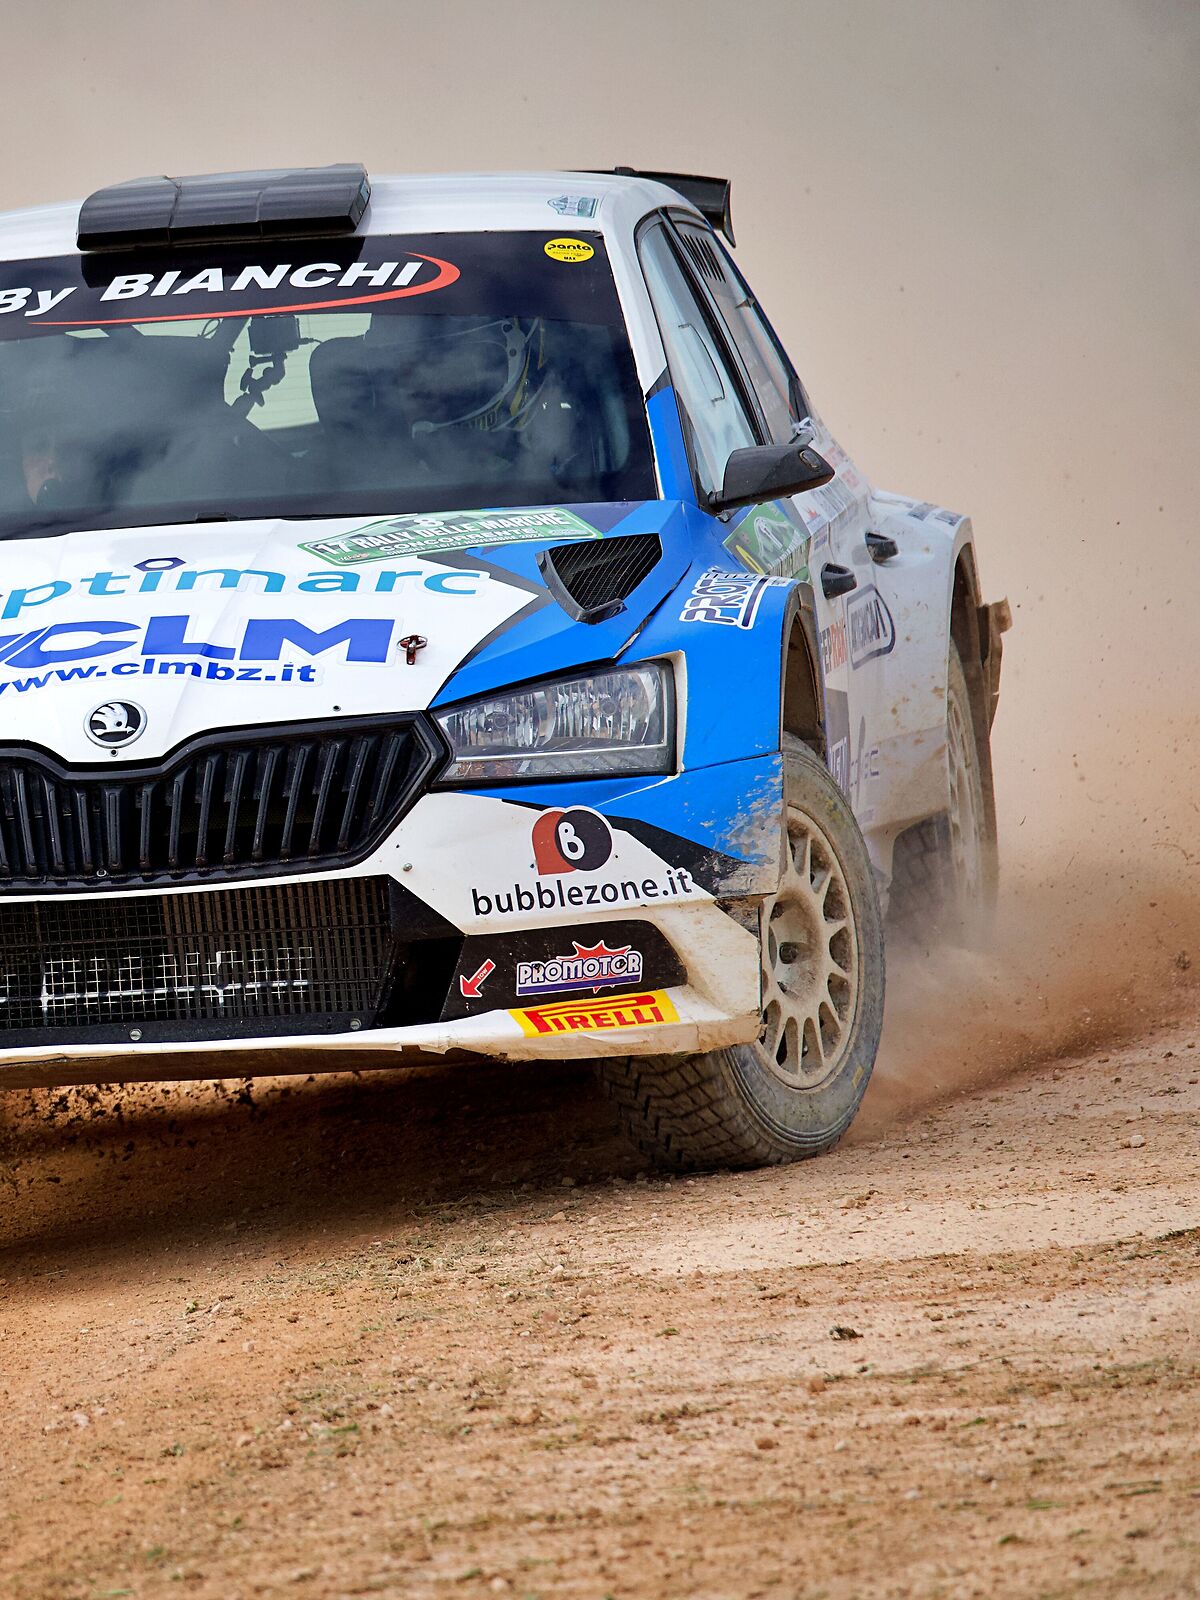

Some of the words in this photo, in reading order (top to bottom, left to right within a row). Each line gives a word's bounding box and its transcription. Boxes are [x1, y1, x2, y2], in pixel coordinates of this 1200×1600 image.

[547, 243, 591, 251] panta
[99, 261, 424, 302] BIANCHI
[350, 530, 417, 549] RALLY
[413, 522, 481, 538] DELLE
[476, 511, 572, 531] MARCHE
[379, 527, 540, 552] CONCORRENTE
[3, 615, 396, 668] CLM
[471, 869, 693, 916] bubblezone.it
[477, 968, 488, 980] TOW
[519, 952, 642, 985] PROMOTOR
[522, 994, 665, 1034] PIRELLI
